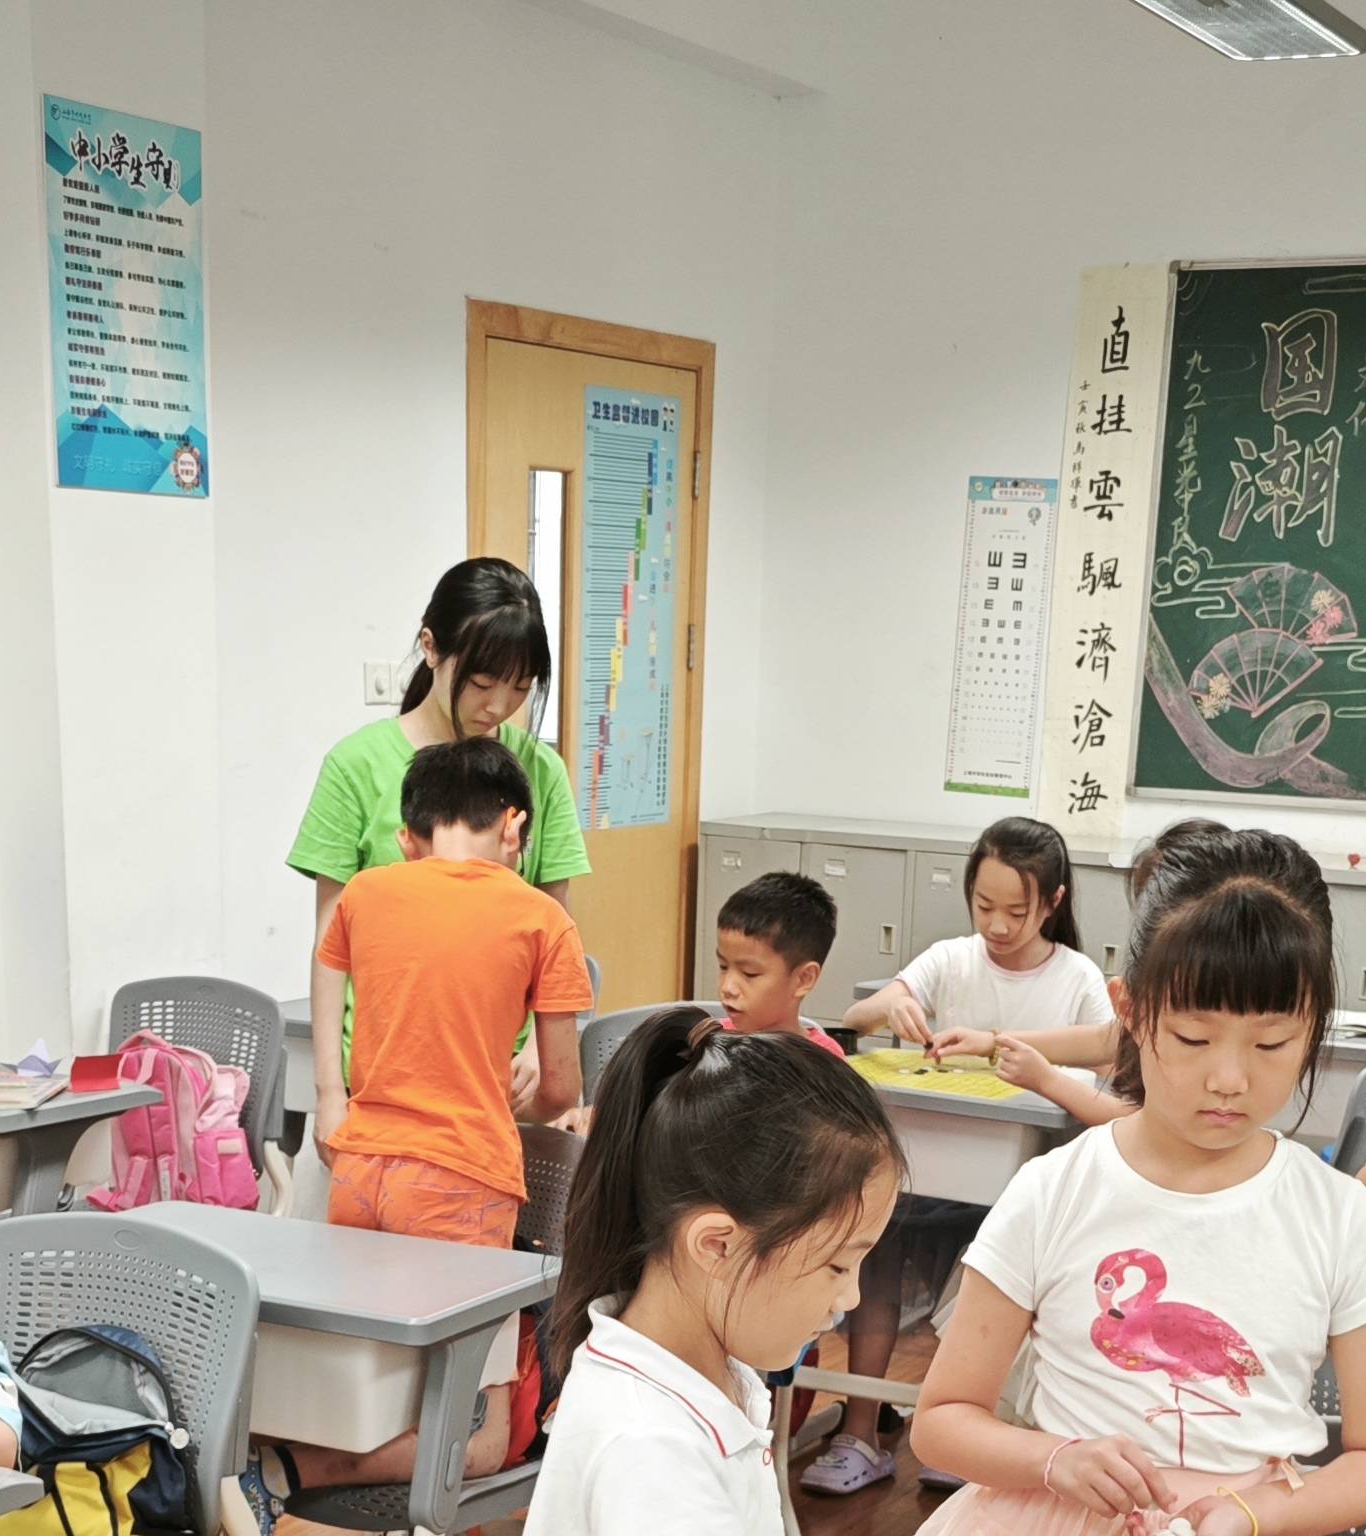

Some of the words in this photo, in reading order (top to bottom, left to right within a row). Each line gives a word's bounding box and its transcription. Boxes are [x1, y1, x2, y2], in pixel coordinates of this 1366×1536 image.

[71, 130, 180, 190] 中小学生守则
[1219, 308, 1343, 547] 国潮
